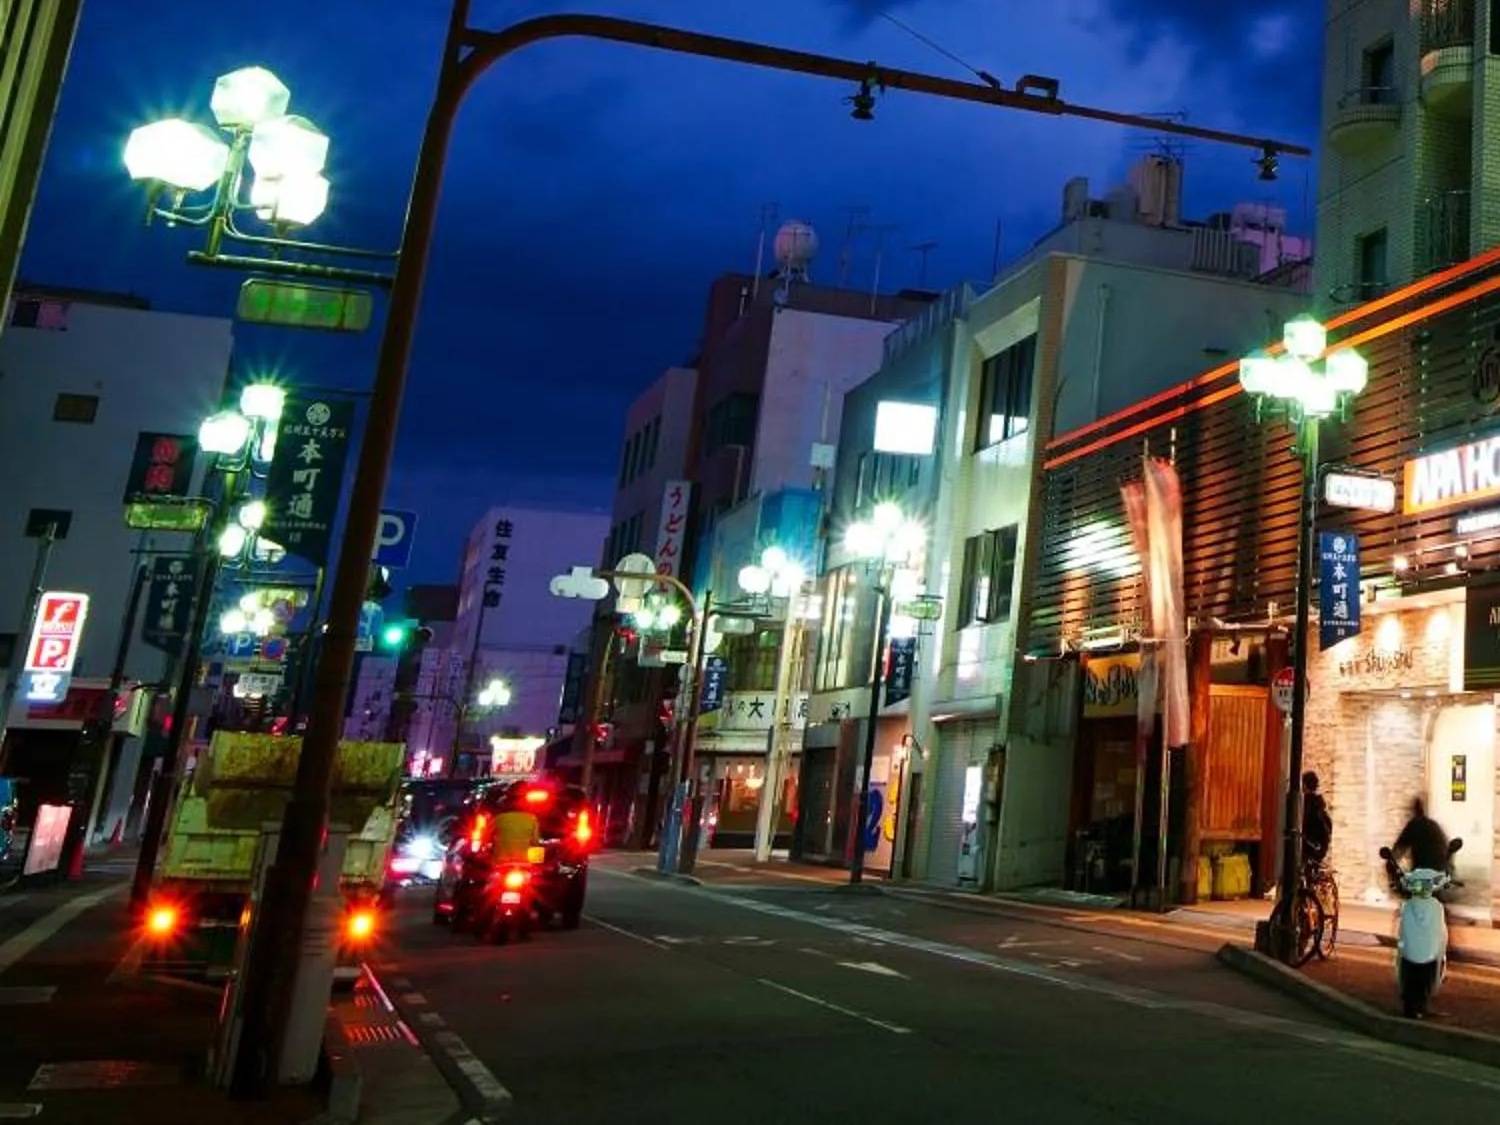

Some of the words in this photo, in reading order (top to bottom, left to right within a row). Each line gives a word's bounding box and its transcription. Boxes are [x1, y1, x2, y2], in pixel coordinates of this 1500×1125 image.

[286, 438, 324, 519] 本町通
[1412, 449, 1468, 510] APA
[1331, 562, 1349, 620] 本町通
